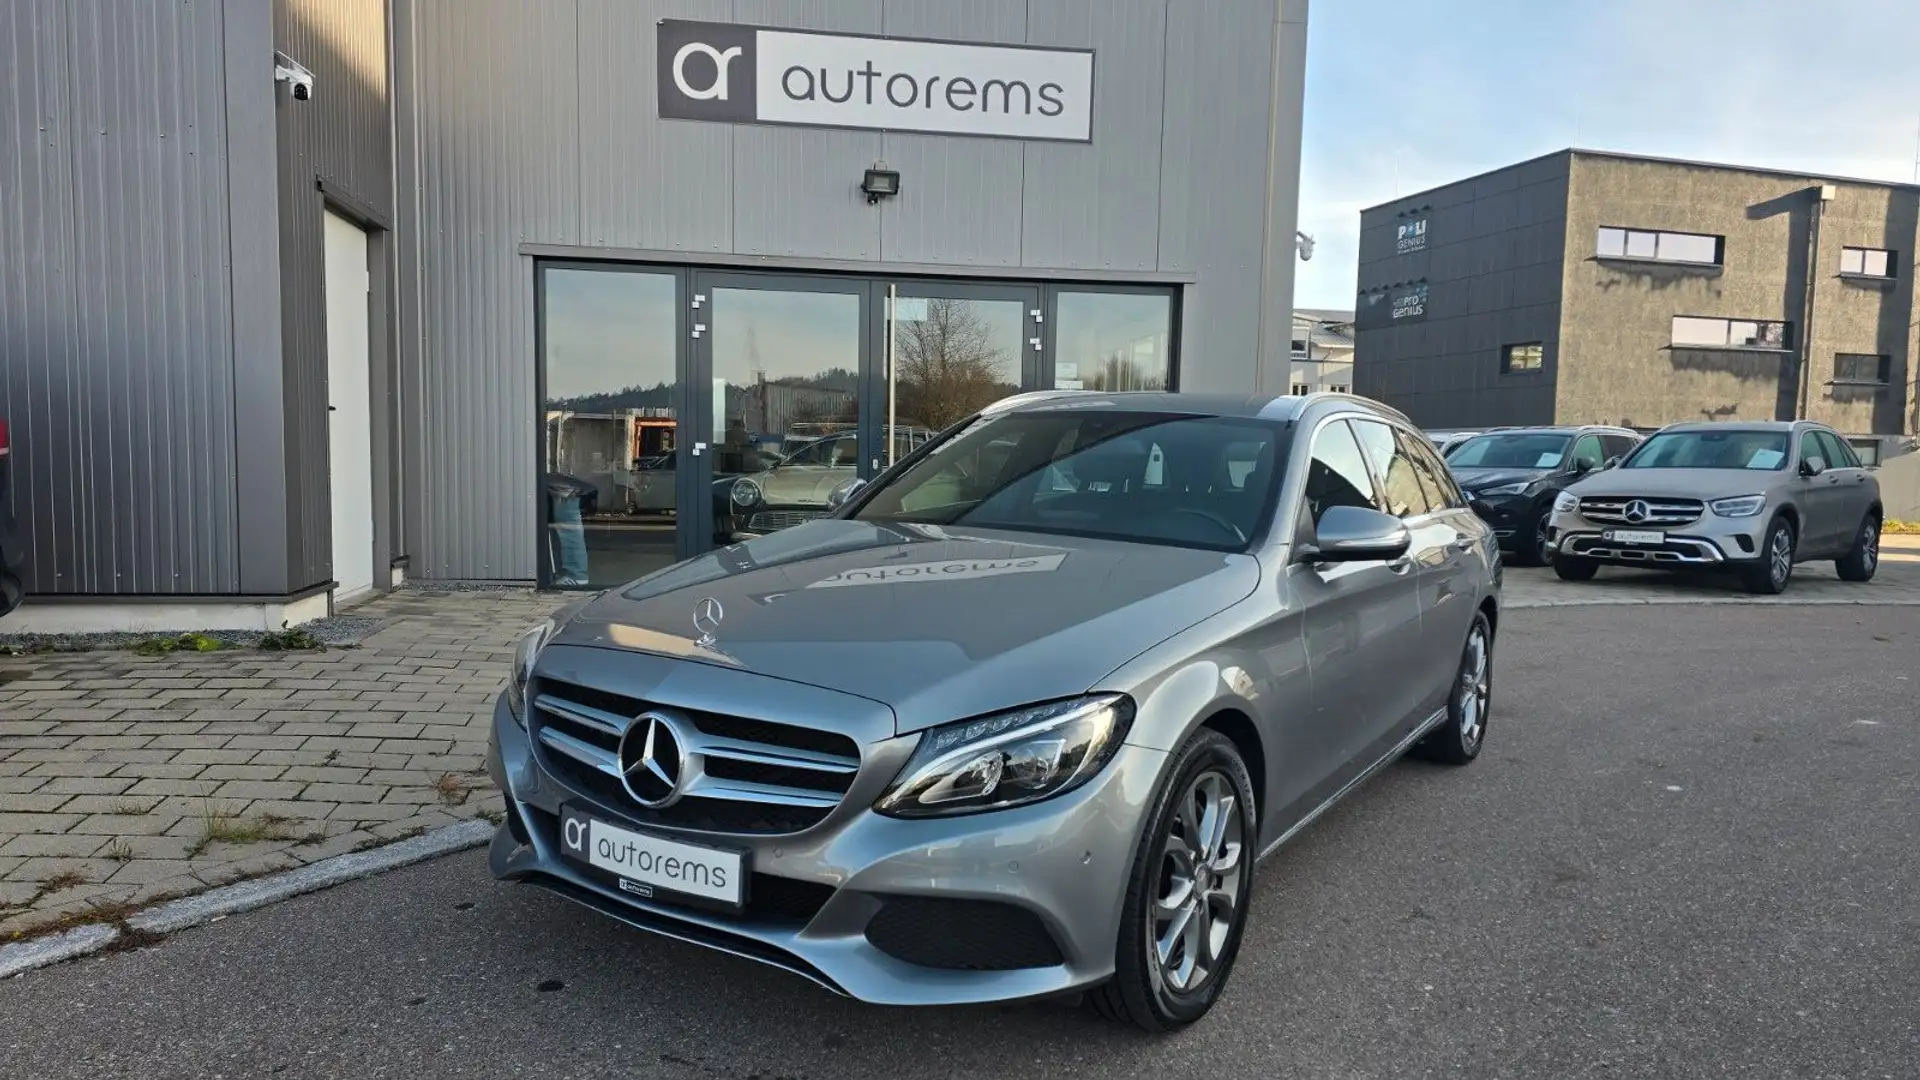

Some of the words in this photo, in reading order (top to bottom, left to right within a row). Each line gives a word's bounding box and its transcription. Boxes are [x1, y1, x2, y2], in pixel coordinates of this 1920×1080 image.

[781, 59, 1065, 117] autorems
[1397, 234, 1426, 250] GENIUS
[598, 837, 727, 888] autorems
